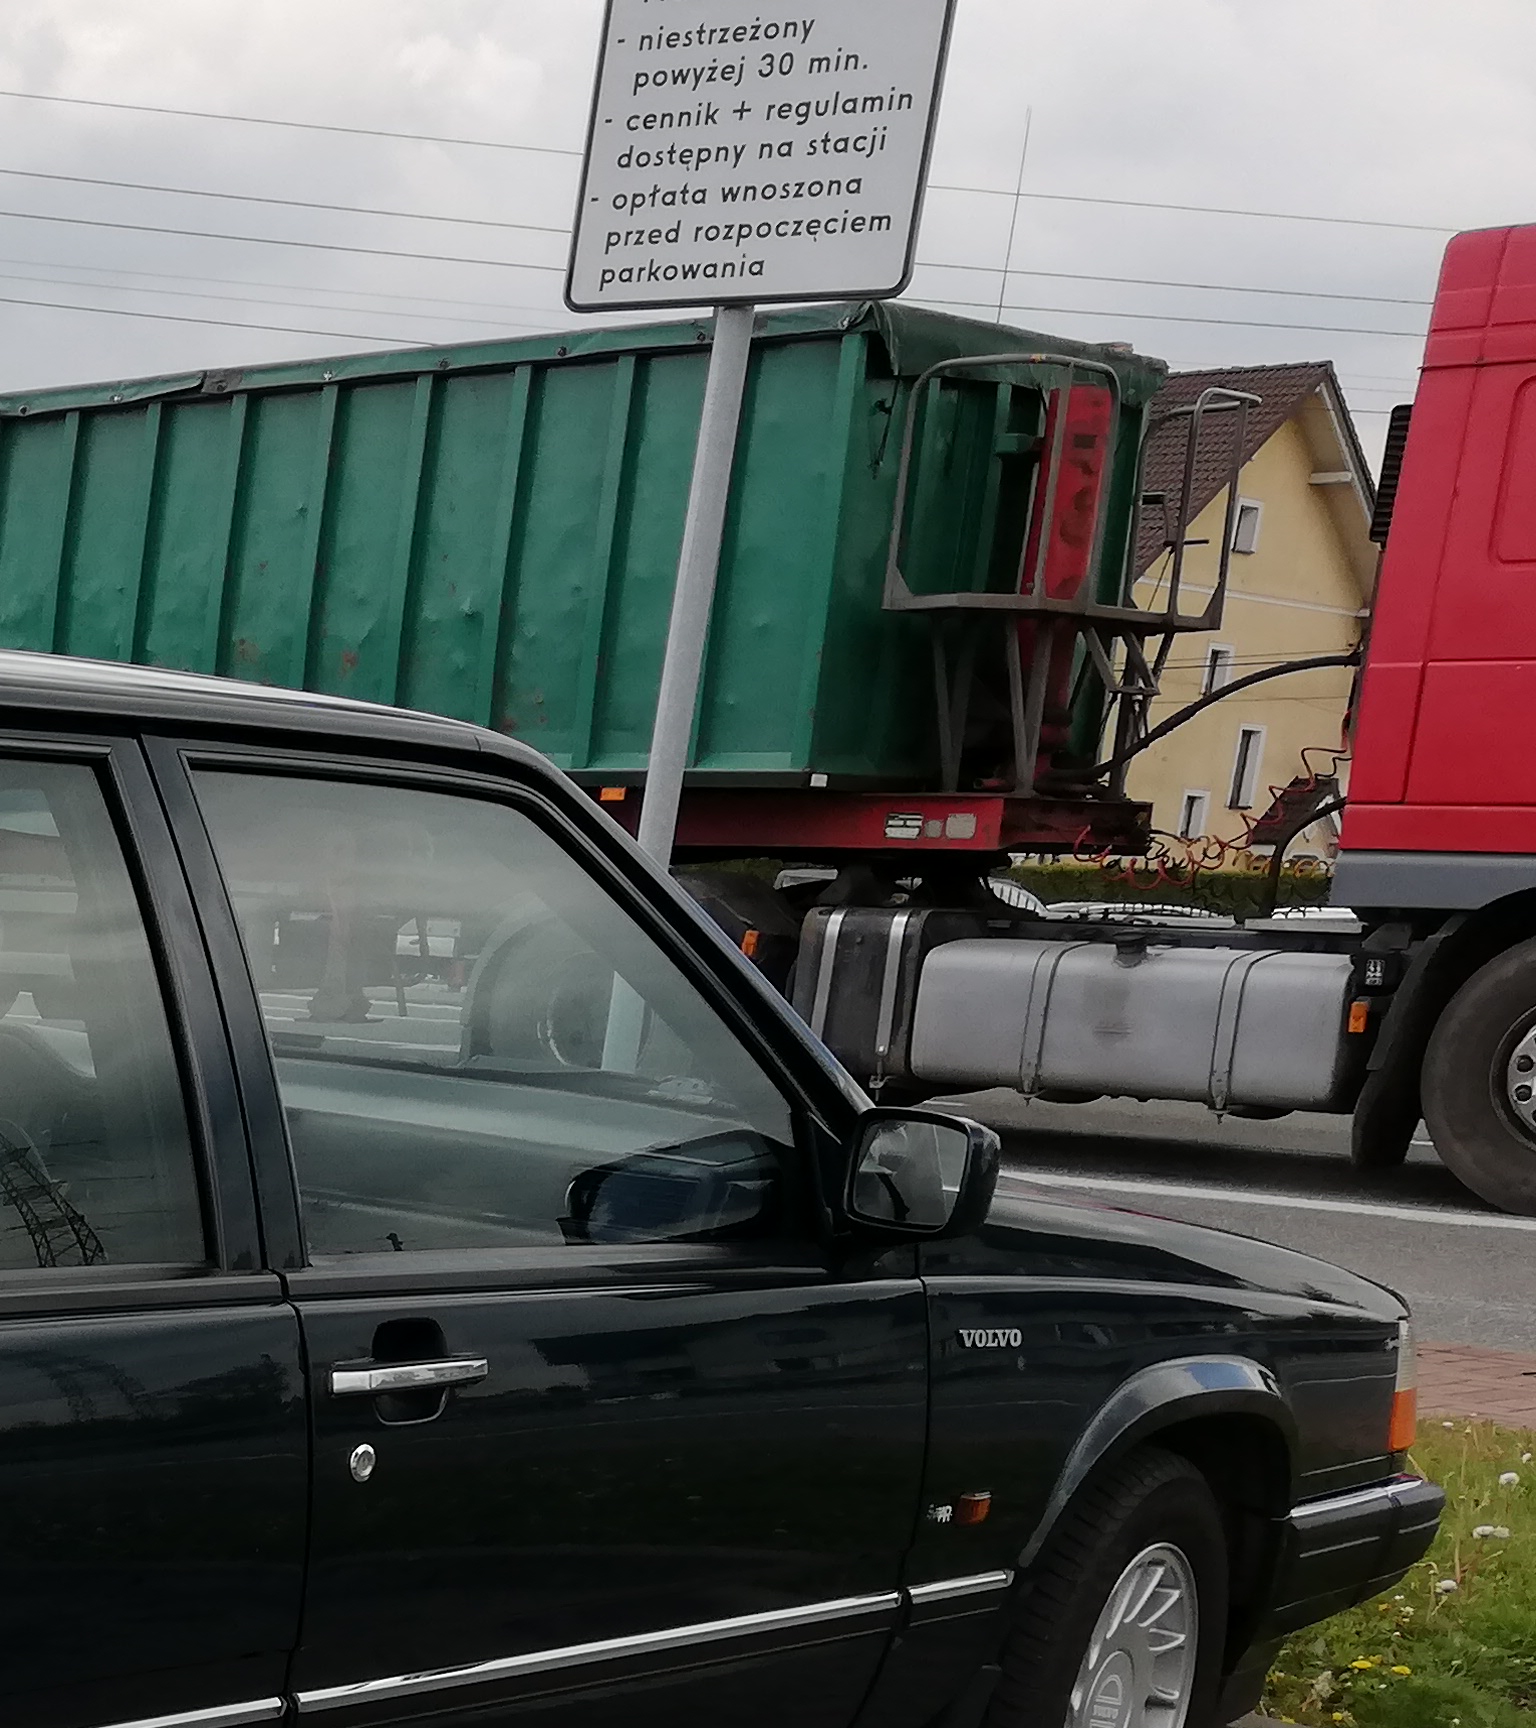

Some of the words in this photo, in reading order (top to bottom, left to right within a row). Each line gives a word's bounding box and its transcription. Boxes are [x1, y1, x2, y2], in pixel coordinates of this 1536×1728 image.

[638, 16, 816, 52] niestrzeżony
[632, 56, 746, 97] powyżej
[757, 52, 794, 78] 30
[808, 47, 868, 75] min.
[626, 101, 720, 132] cennik
[765, 86, 913, 126] regulamin
[616, 142, 747, 172] dostępny
[758, 140, 794, 160] na
[806, 125, 888, 159] stacji
[612, 182, 708, 217] opłata
[721, 177, 863, 203] wnoszona
[604, 219, 682, 255] przed
[693, 209, 892, 248] rozpoczęciem
[598, 253, 765, 292] parkowania
[959, 1328, 1023, 1348] VOLVO
